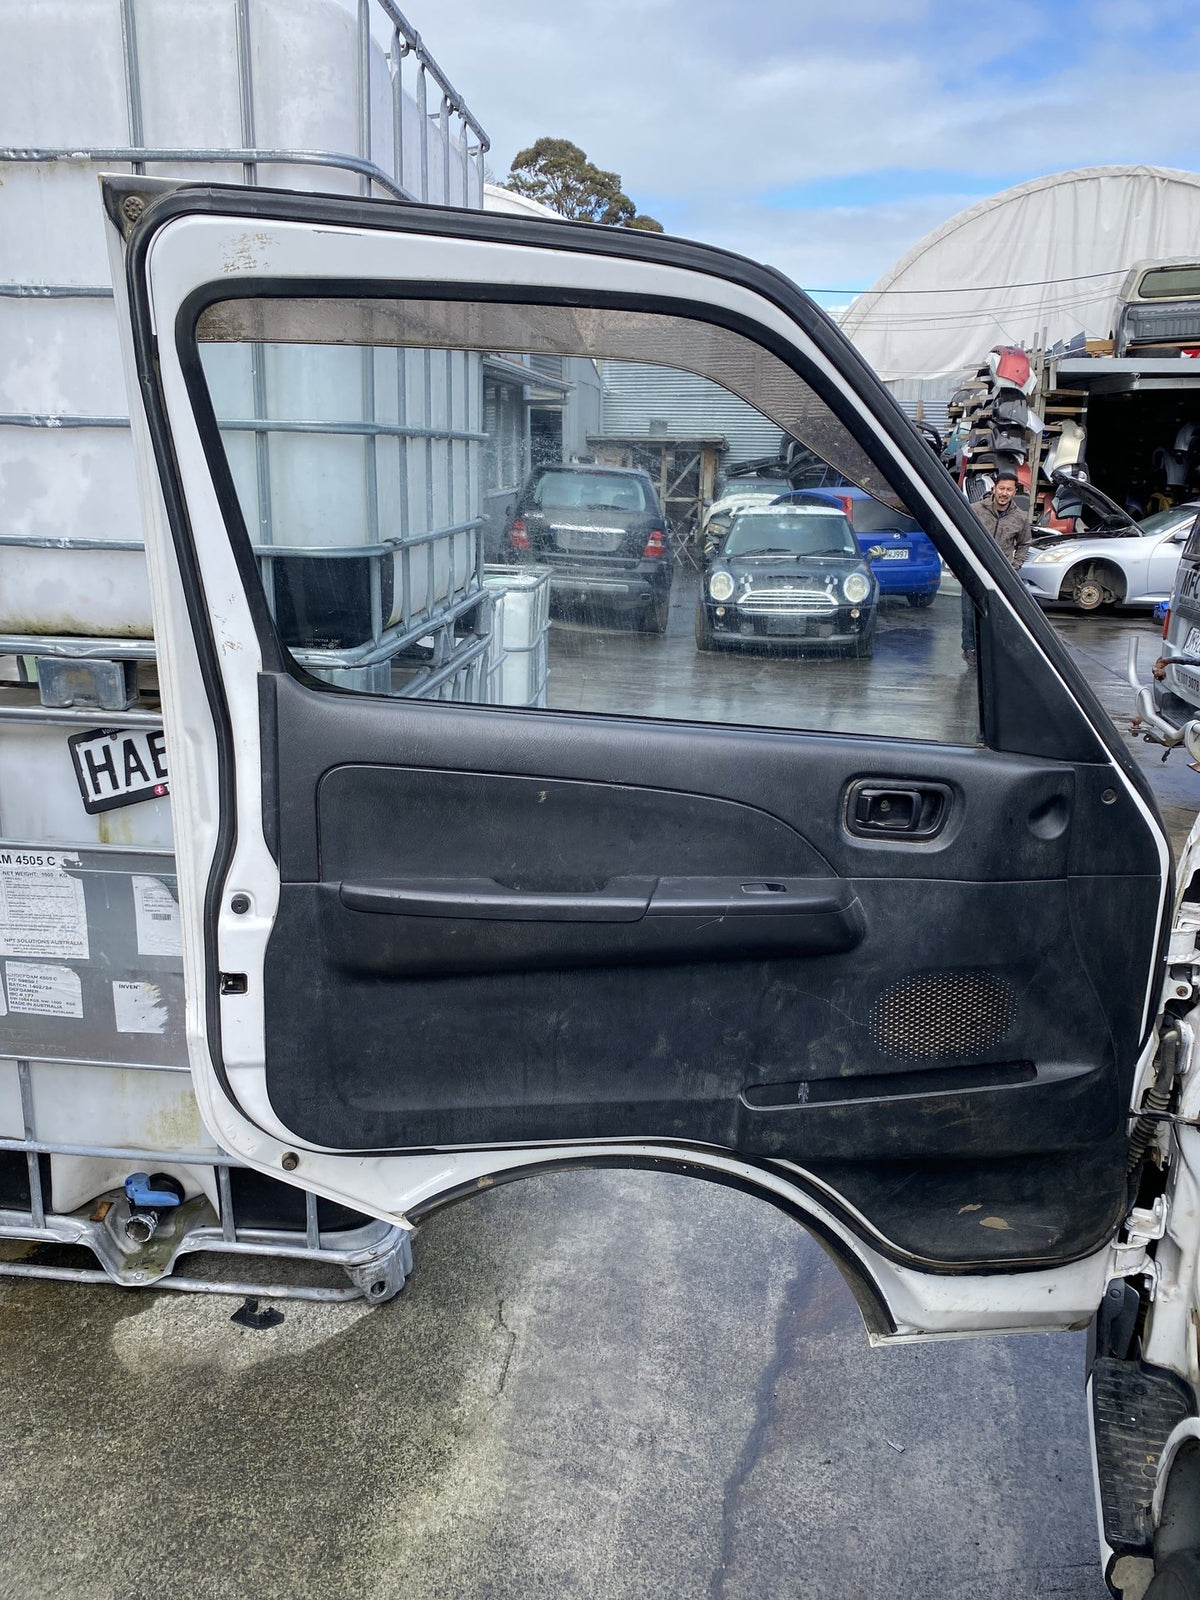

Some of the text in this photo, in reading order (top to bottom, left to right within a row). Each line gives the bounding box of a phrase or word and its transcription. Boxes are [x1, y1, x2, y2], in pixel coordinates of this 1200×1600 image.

[0, 854, 56, 866] M 4505 C
